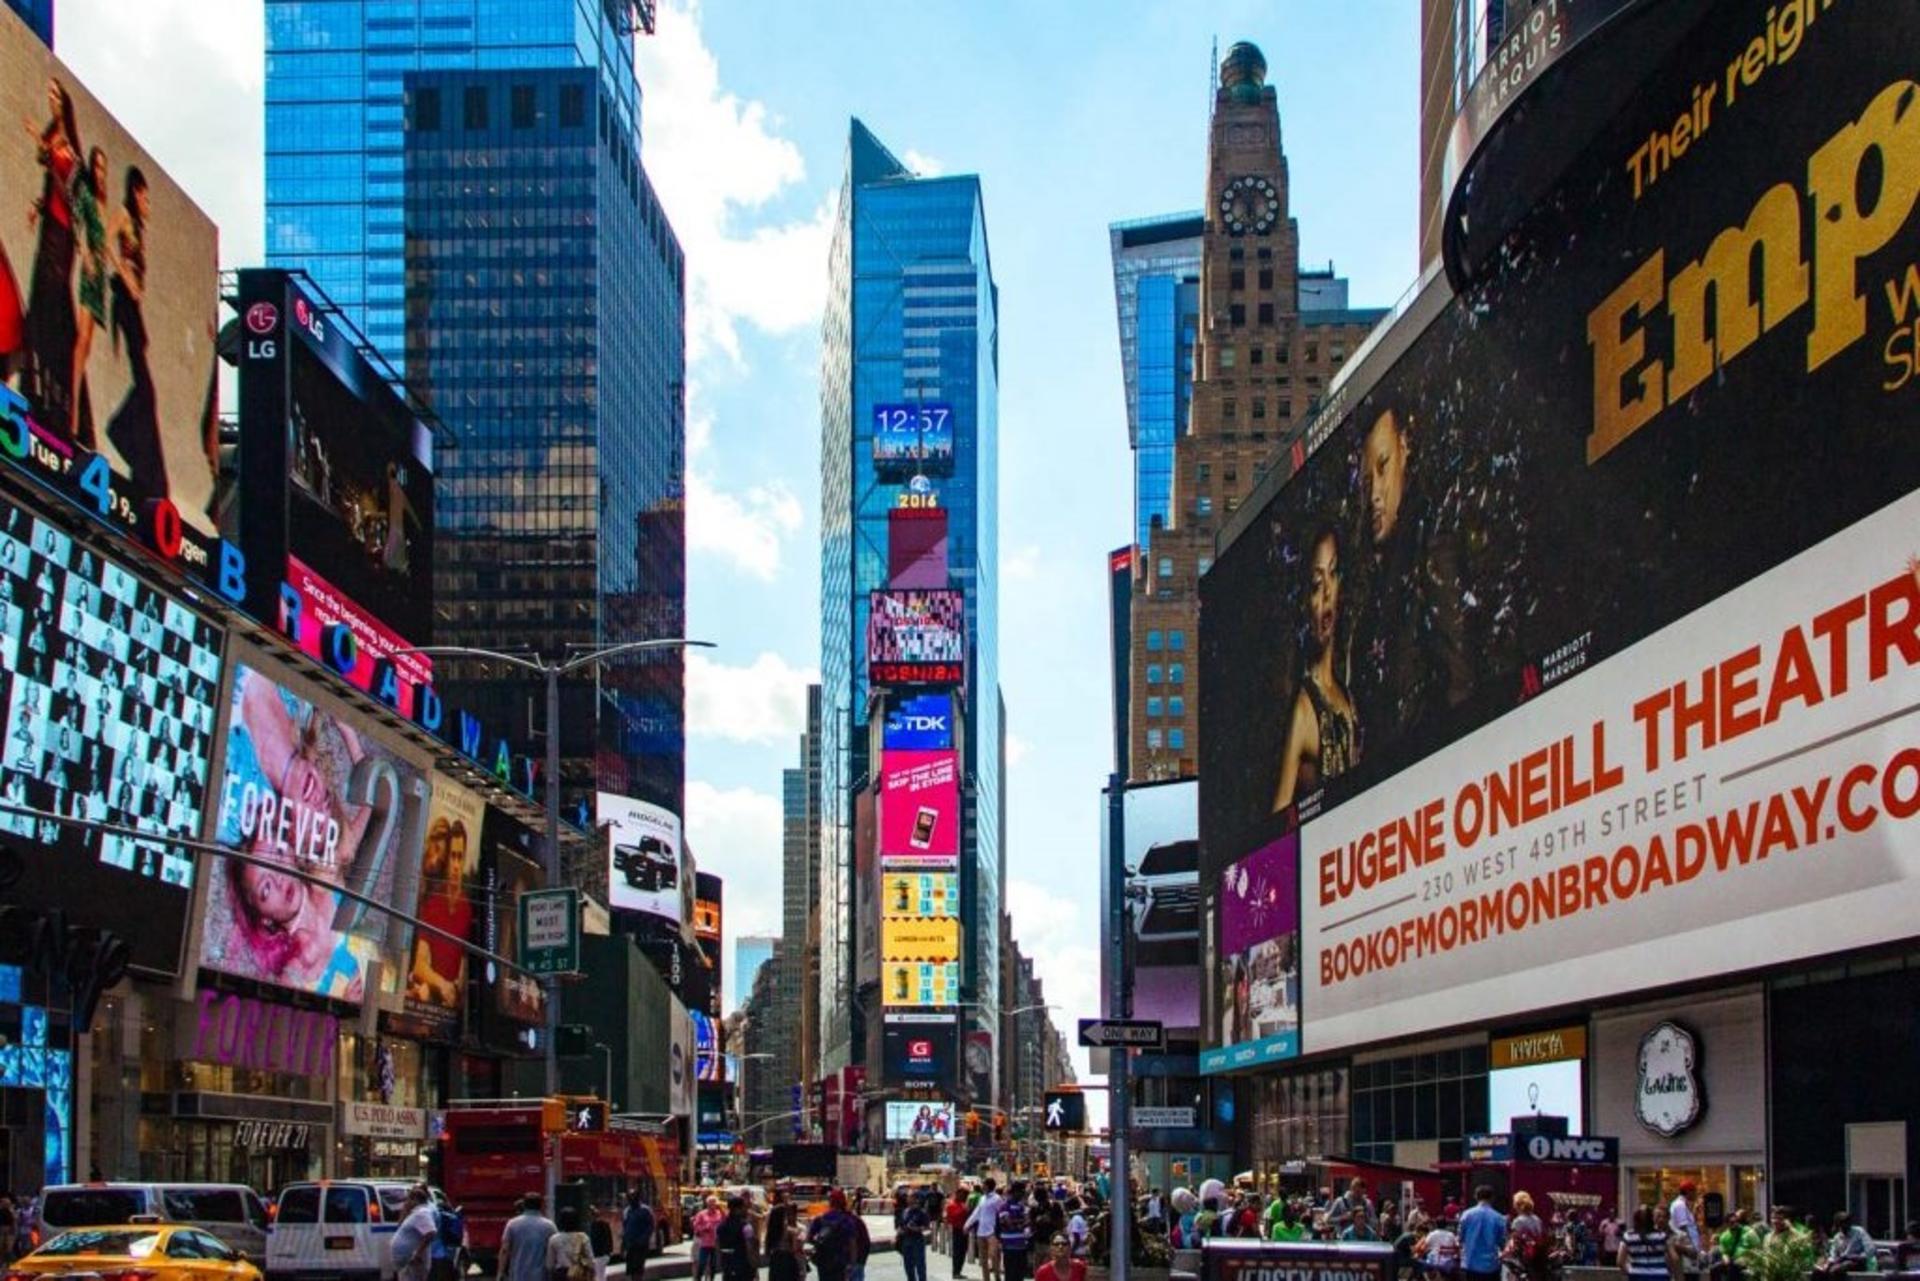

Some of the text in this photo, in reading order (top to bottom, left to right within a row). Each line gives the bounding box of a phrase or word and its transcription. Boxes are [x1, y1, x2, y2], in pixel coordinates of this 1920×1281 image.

[1625, 79, 1717, 200] Their
[309, 311, 324, 342] LG
[249, 341, 276, 359] LG
[877, 408, 948, 433] 12:57
[899, 494, 937, 507] 2016
[1543, 631, 1592, 670] MARRIOTT
[872, 666, 962, 681] TOSHIBA
[1543, 651, 1586, 687] MARQUIS
[905, 716, 946, 731] TDK
[1319, 572, 1920, 907] EUGENE O'NEILL THEATR
[222, 773, 339, 868] FOREVER
[1422, 773, 1706, 901] 230 WEST 49TH STREET
[1320, 747, 1920, 986] BOOKOFMORMONBROADWAY.CO
[194, 988, 340, 1077] FOREVER
[1511, 1033, 1564, 1061] INVICTA
[905, 1080, 935, 1088] SONY
[233, 1121, 309, 1149] FOREVER 21
[1554, 1140, 1605, 1160] NYC
